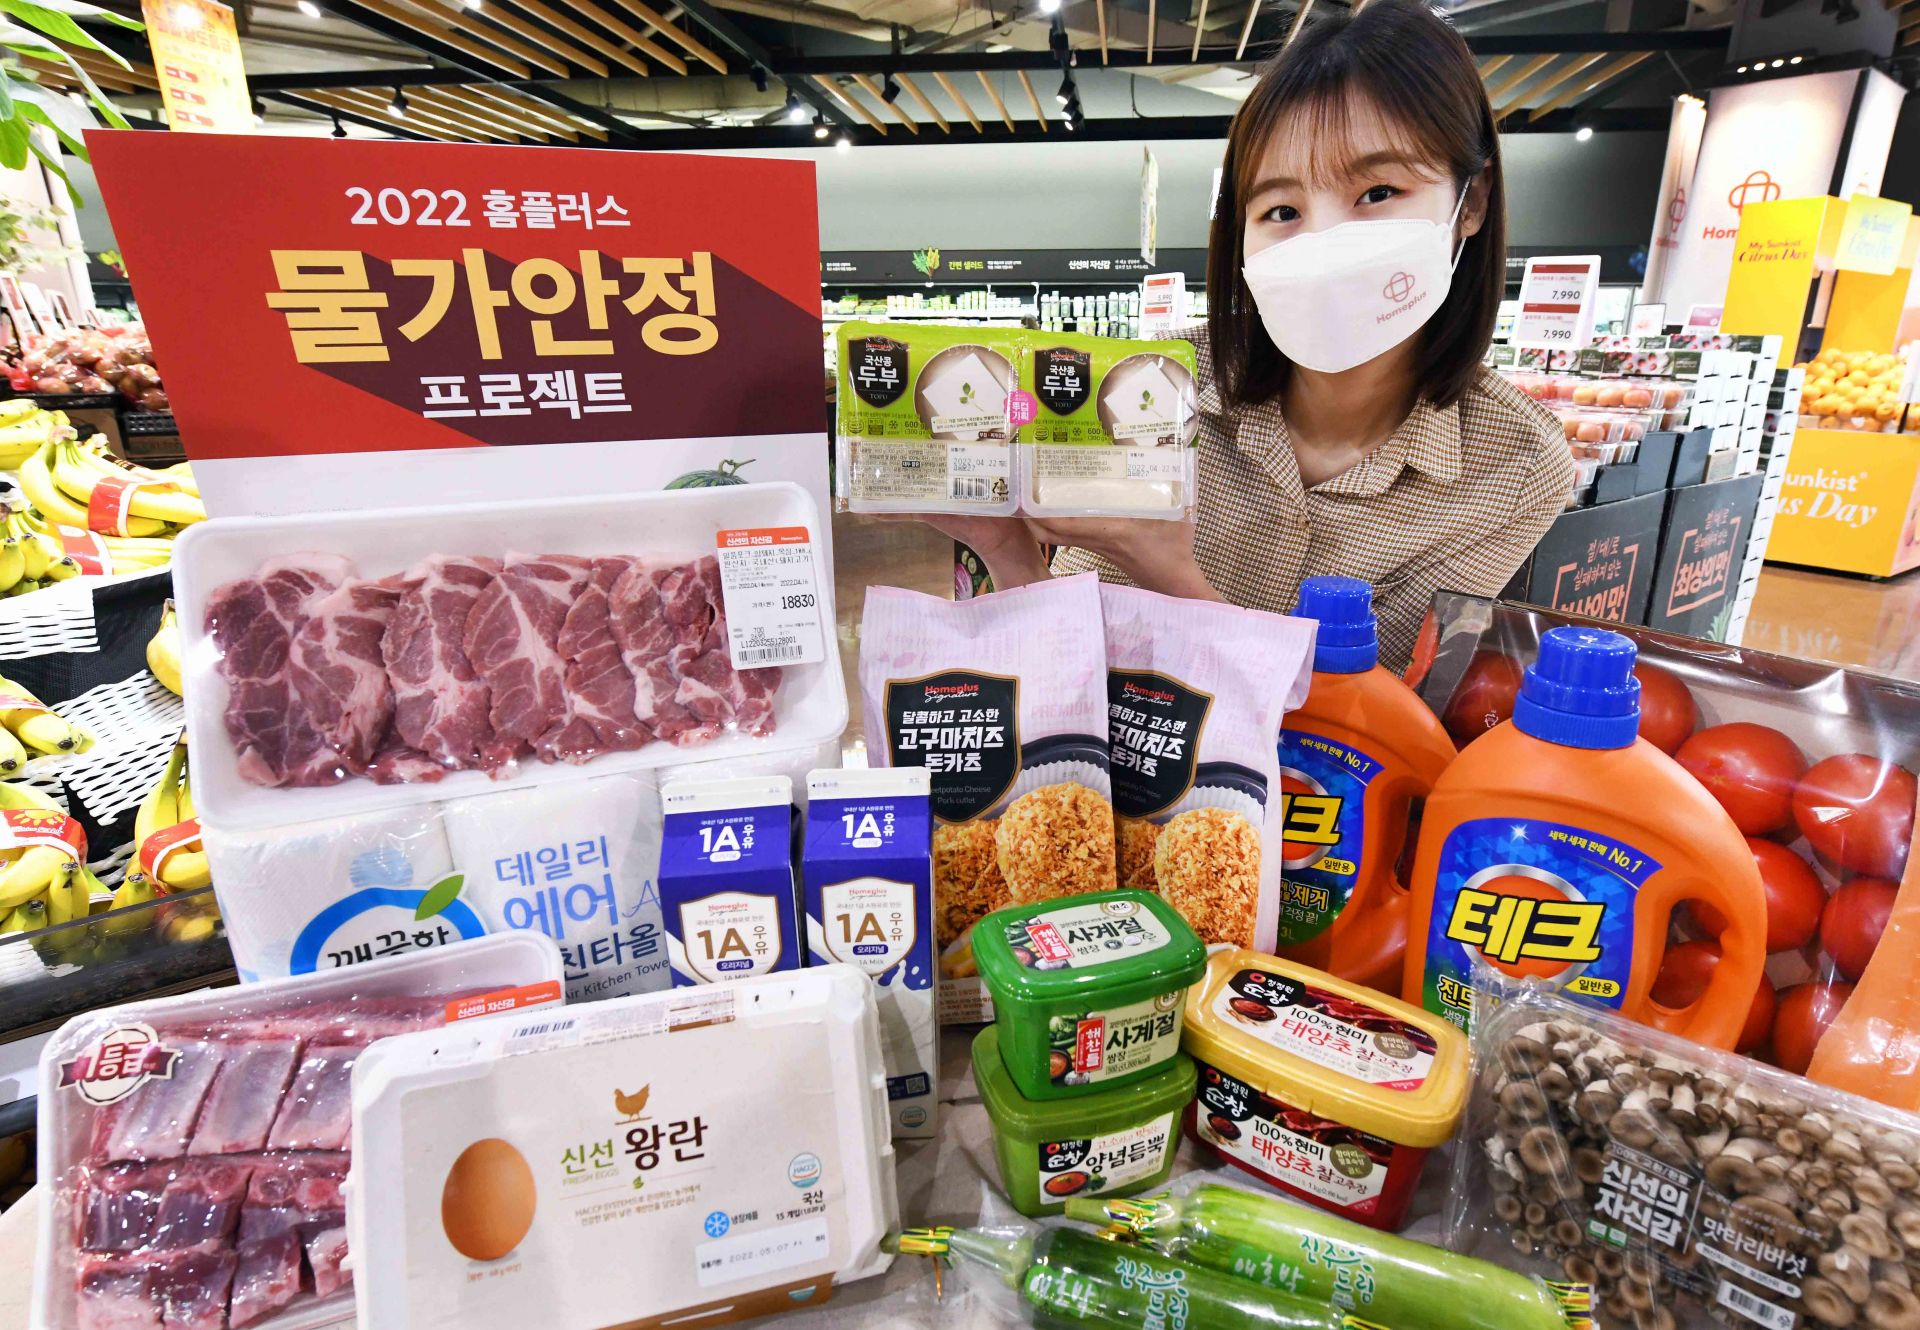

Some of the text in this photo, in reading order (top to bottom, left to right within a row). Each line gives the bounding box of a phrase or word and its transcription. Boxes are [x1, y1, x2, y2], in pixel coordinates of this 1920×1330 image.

[344, 186, 632, 231] 2022 홈플러스
[265, 247, 720, 364] 물가안정
[1376, 291, 1427, 324] Homeplus
[1552, 290, 1580, 300] 7,990
[1543, 330, 1571, 339] 7,990
[864, 355, 892, 367] 국산콩
[1049, 364, 1075, 377] 국산콩
[858, 366, 899, 389] 두부
[1043, 376, 1082, 398] 두부
[421, 371, 633, 420] 프로젝트
[1782, 468, 1858, 491] unkist
[1805, 491, 1878, 528] Day
[782, 594, 815, 610] 18830
[925, 684, 979, 694] Homeplus
[925, 690, 979, 703] Signature
[1122, 688, 1173, 707] Signature
[1124, 681, 1175, 701] Homeplus
[903, 709, 999, 725] 달콤하고 고소한
[1109, 703, 1187, 735] 콤하고 고소한
[898, 726, 1004, 751] 고구마치즈
[1109, 720, 1186, 761] 구마치즈
[925, 753, 982, 773] 돈카츠
[1111, 745, 1158, 778] 돈카츠
[1300, 738, 1313, 748] 세탁
[1344, 752, 1371, 773] No.1
[931, 786, 963, 795] eetpotato
[842, 813, 882, 839] 1A
[883, 812, 895, 837] 우유
[1283, 796, 1342, 844] 크
[699, 825, 741, 853] 1A
[742, 824, 755, 849] 우유
[495, 835, 610, 887] 데일리
[1549, 830, 1643, 873] 세탁 세제 판매 No.1
[1323, 859, 1350, 873] 일반용
[503, 873, 620, 945] 에어
[708, 902, 748, 911] Homeplus
[1293, 884, 1327, 911] 제거
[836, 912, 887, 944] 1A
[890, 912, 903, 941] 우유
[1286, 906, 1319, 925] 걱정 끝!
[1446, 889, 1606, 963] 테크
[696, 928, 752, 960] 1A
[753, 925, 768, 956] 우유
[1067, 917, 1146, 944] 사계절
[856, 945, 885, 954] 오리지널
[1077, 945, 1100, 956] 쌈장
[584, 973, 631, 998] Kitchen
[635, 958, 669, 979] Towe
[721, 960, 750, 969] 오리지널
[1243, 982, 1290, 1005] 순창
[1266, 978, 1295, 995] 청정원
[1578, 978, 1613, 995] 일반용
[1106, 1011, 1175, 1050] 사계절
[1281, 1017, 1354, 1056] 태양초
[1290, 1006, 1368, 1045] 100% 현미
[1085, 1028, 1101, 1067] 해찬들
[1106, 1050, 1126, 1064] 쌈장
[1223, 1077, 1249, 1098] 청정원
[1206, 1087, 1248, 1118] 순창
[561, 1116, 709, 1175] 신선 왕란
[1086, 1133, 1165, 1173] 양념듬뿍
[1254, 1119, 1324, 1161] 100% 현미
[1048, 1151, 1084, 1168] 순창
[1251, 1135, 1315, 1178] 태양초
[562, 1173, 593, 1187] FRESH
[1601, 1159, 1690, 1218] 신선의
[802, 1190, 824, 1205] 국산
[731, 1211, 759, 1225] 냉장제품
[1594, 1187, 1682, 1248] 자신감
[1703, 1216, 1808, 1278] 맛타리버섯
[1116, 1256, 1185, 1288] 진주
[1146, 1290, 1190, 1330] 드림
